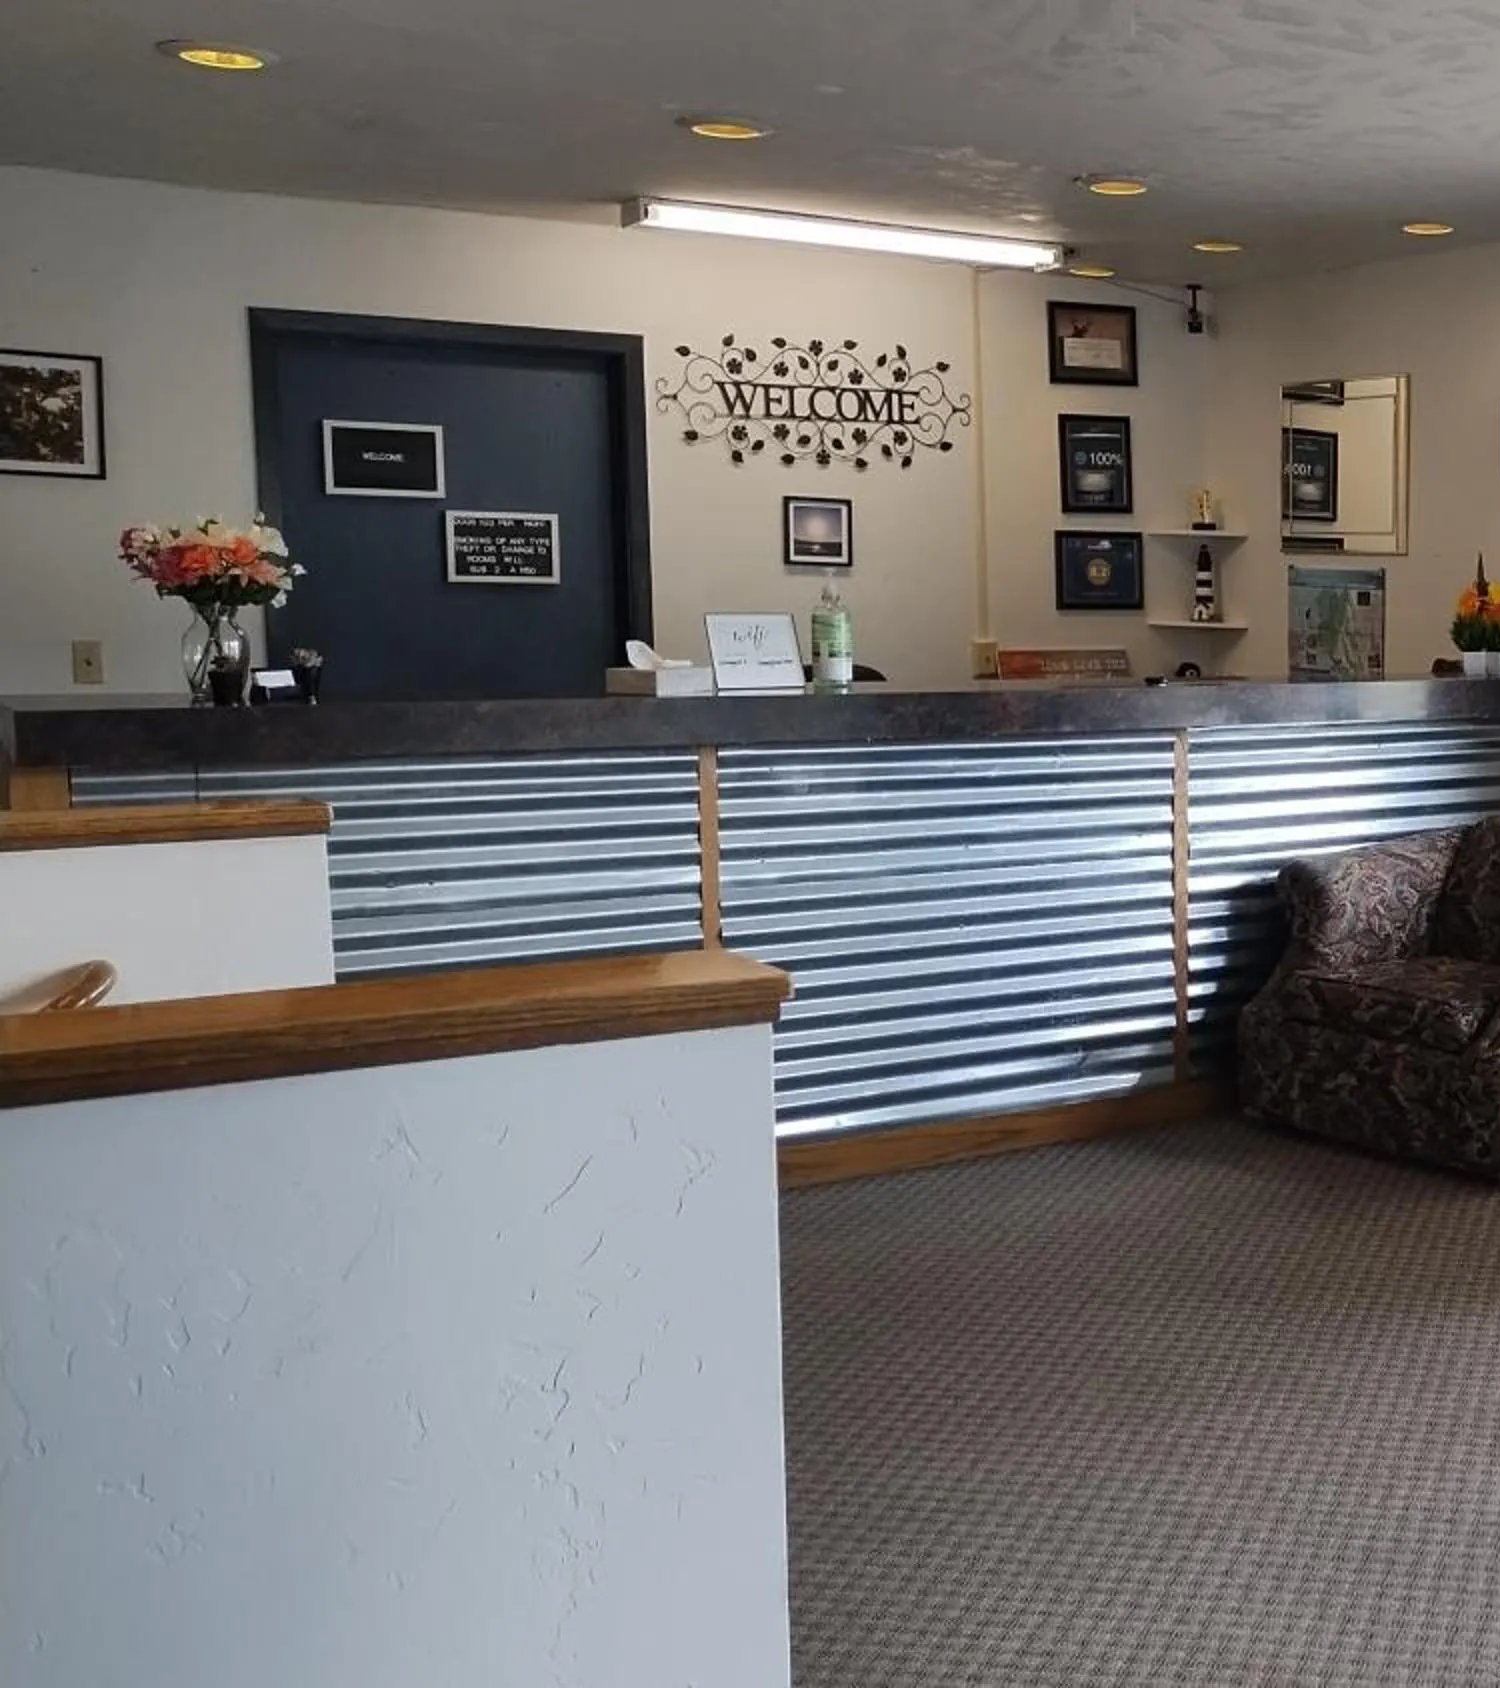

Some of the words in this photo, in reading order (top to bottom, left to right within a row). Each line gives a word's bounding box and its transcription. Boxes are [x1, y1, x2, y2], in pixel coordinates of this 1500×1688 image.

[716, 380, 921, 425] WELCOME
[361, 450, 404, 462] WELCOME
[1089, 451, 1122, 466] 100%
